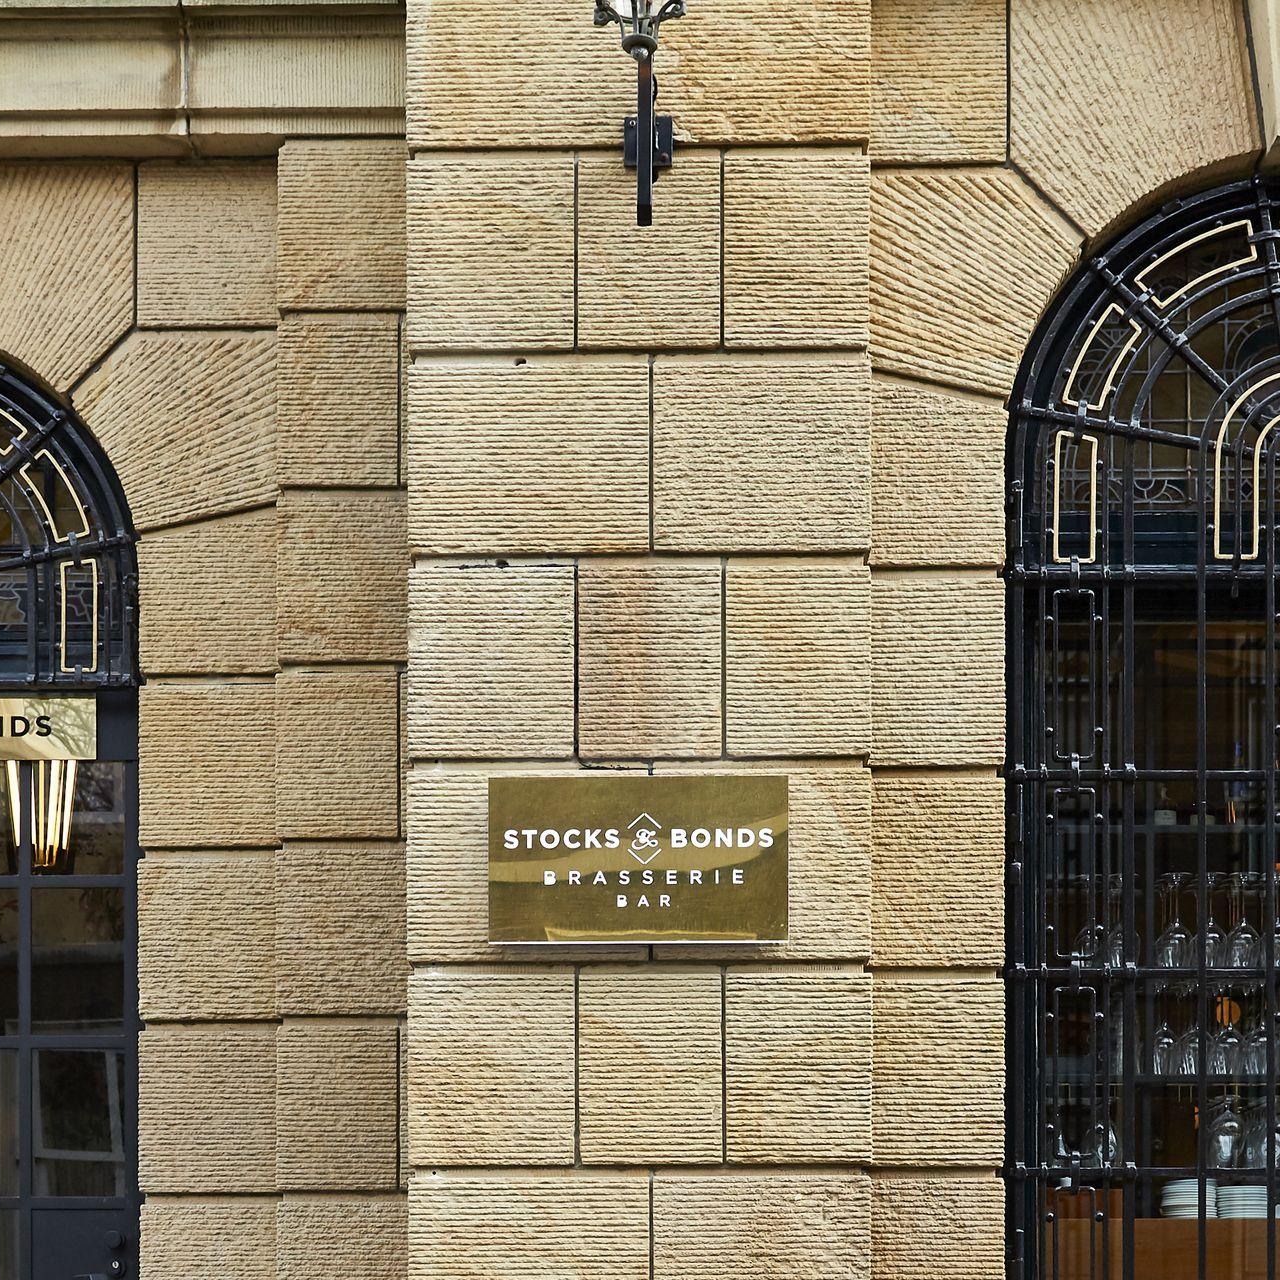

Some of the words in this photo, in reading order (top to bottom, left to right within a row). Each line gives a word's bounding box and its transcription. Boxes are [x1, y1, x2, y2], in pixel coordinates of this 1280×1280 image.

[503, 828, 620, 850] STOCKS
[631, 828, 659, 851] &
[670, 827, 774, 849] BONDS
[543, 868, 744, 886] BRASSERIE
[616, 894, 671, 908] BAR
